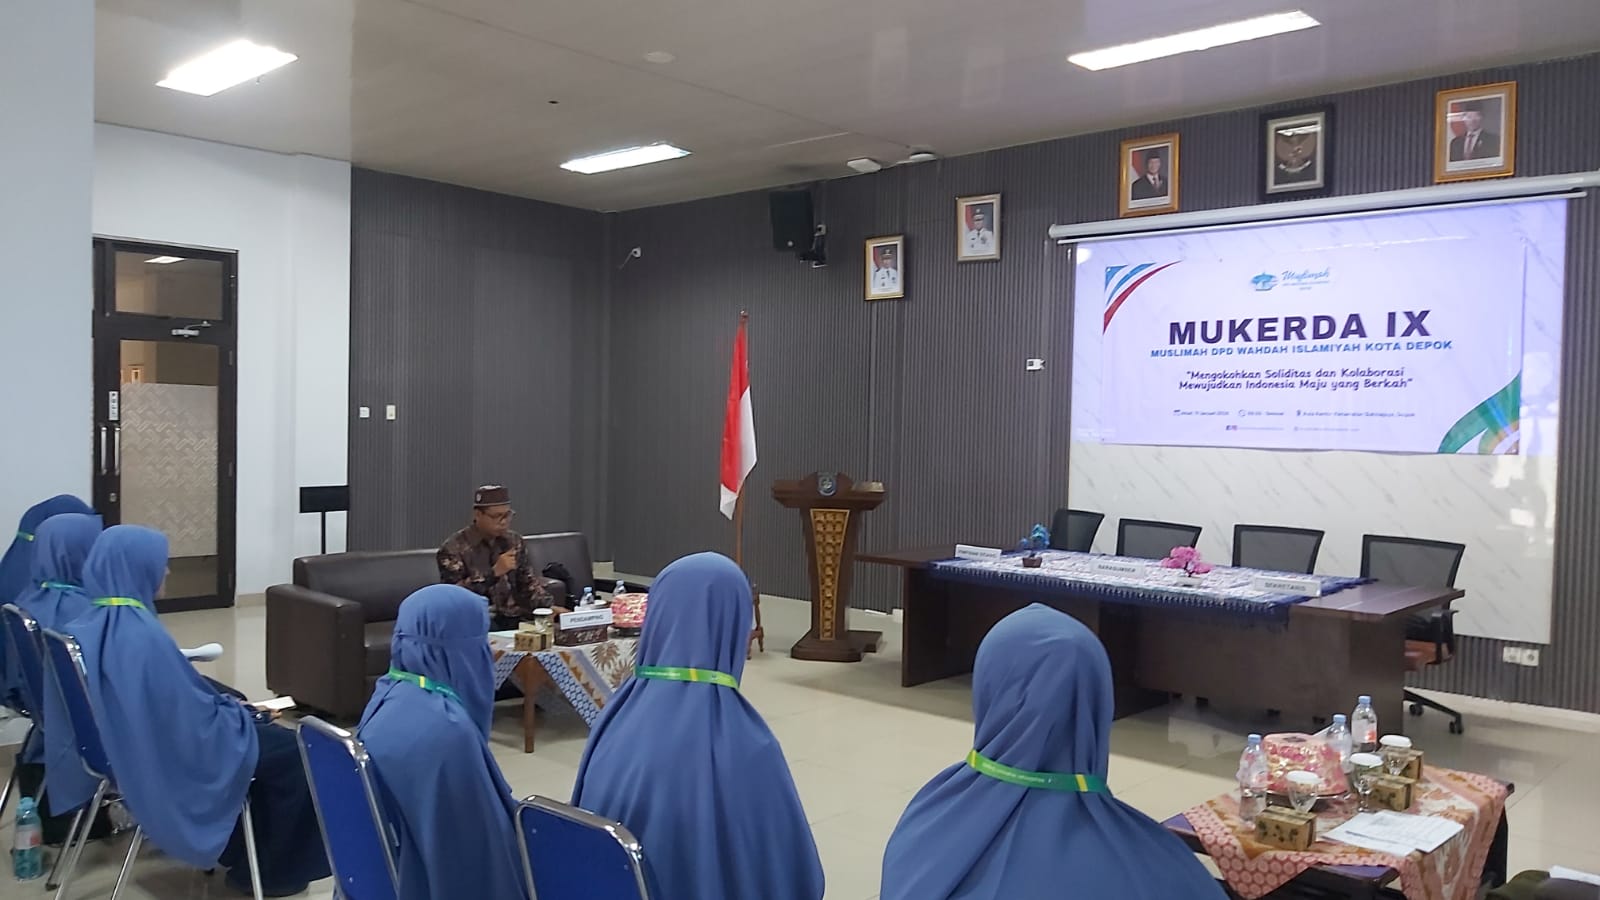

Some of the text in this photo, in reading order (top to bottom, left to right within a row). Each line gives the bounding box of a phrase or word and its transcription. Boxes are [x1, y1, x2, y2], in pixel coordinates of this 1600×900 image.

[1169, 309, 1431, 345] MUKERDA IX
[1150, 340, 1453, 357] MUSLIMAH DPD WAHDAH ISLAMIYAH KOTA DEPOK
[1265, 368, 1312, 379] Soliditas
[1315, 368, 1337, 378] dan
[1341, 367, 1405, 377] Kolaborasi
[1179, 380, 1242, 391] Mewujudkan
[1246, 379, 1295, 389] Indonesia
[1299, 379, 1327, 391] Maju
[1331, 380, 1360, 391] yang
